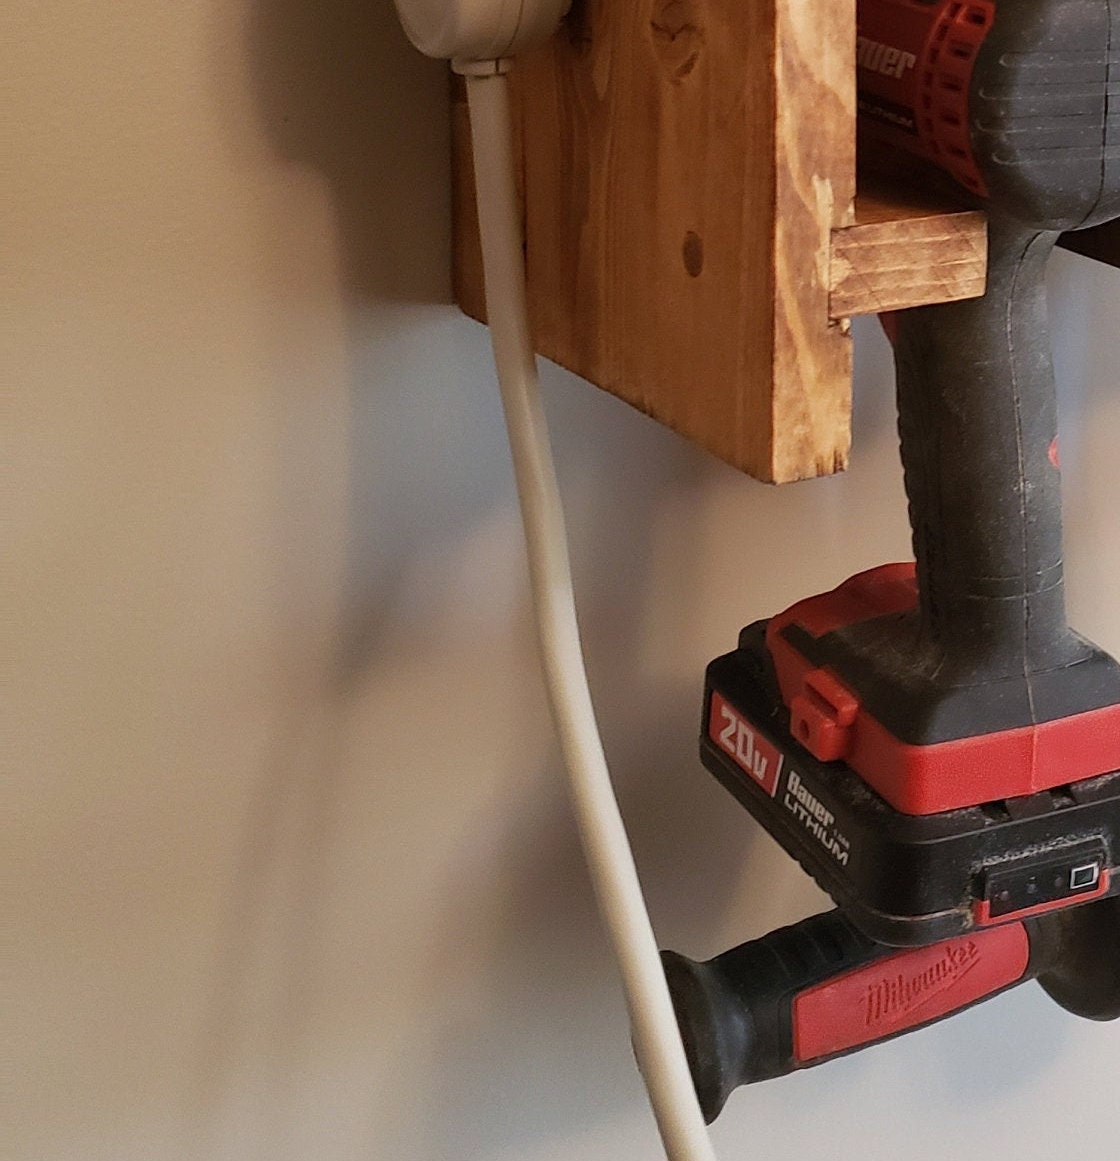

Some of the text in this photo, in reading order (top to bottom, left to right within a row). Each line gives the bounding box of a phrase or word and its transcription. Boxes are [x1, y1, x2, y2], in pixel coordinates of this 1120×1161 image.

[857, 34, 916, 79] auer
[784, 793, 849, 867] LITHIUM
[786, 770, 835, 827] Bauer
[859, 941, 979, 1025] Milwaukee
